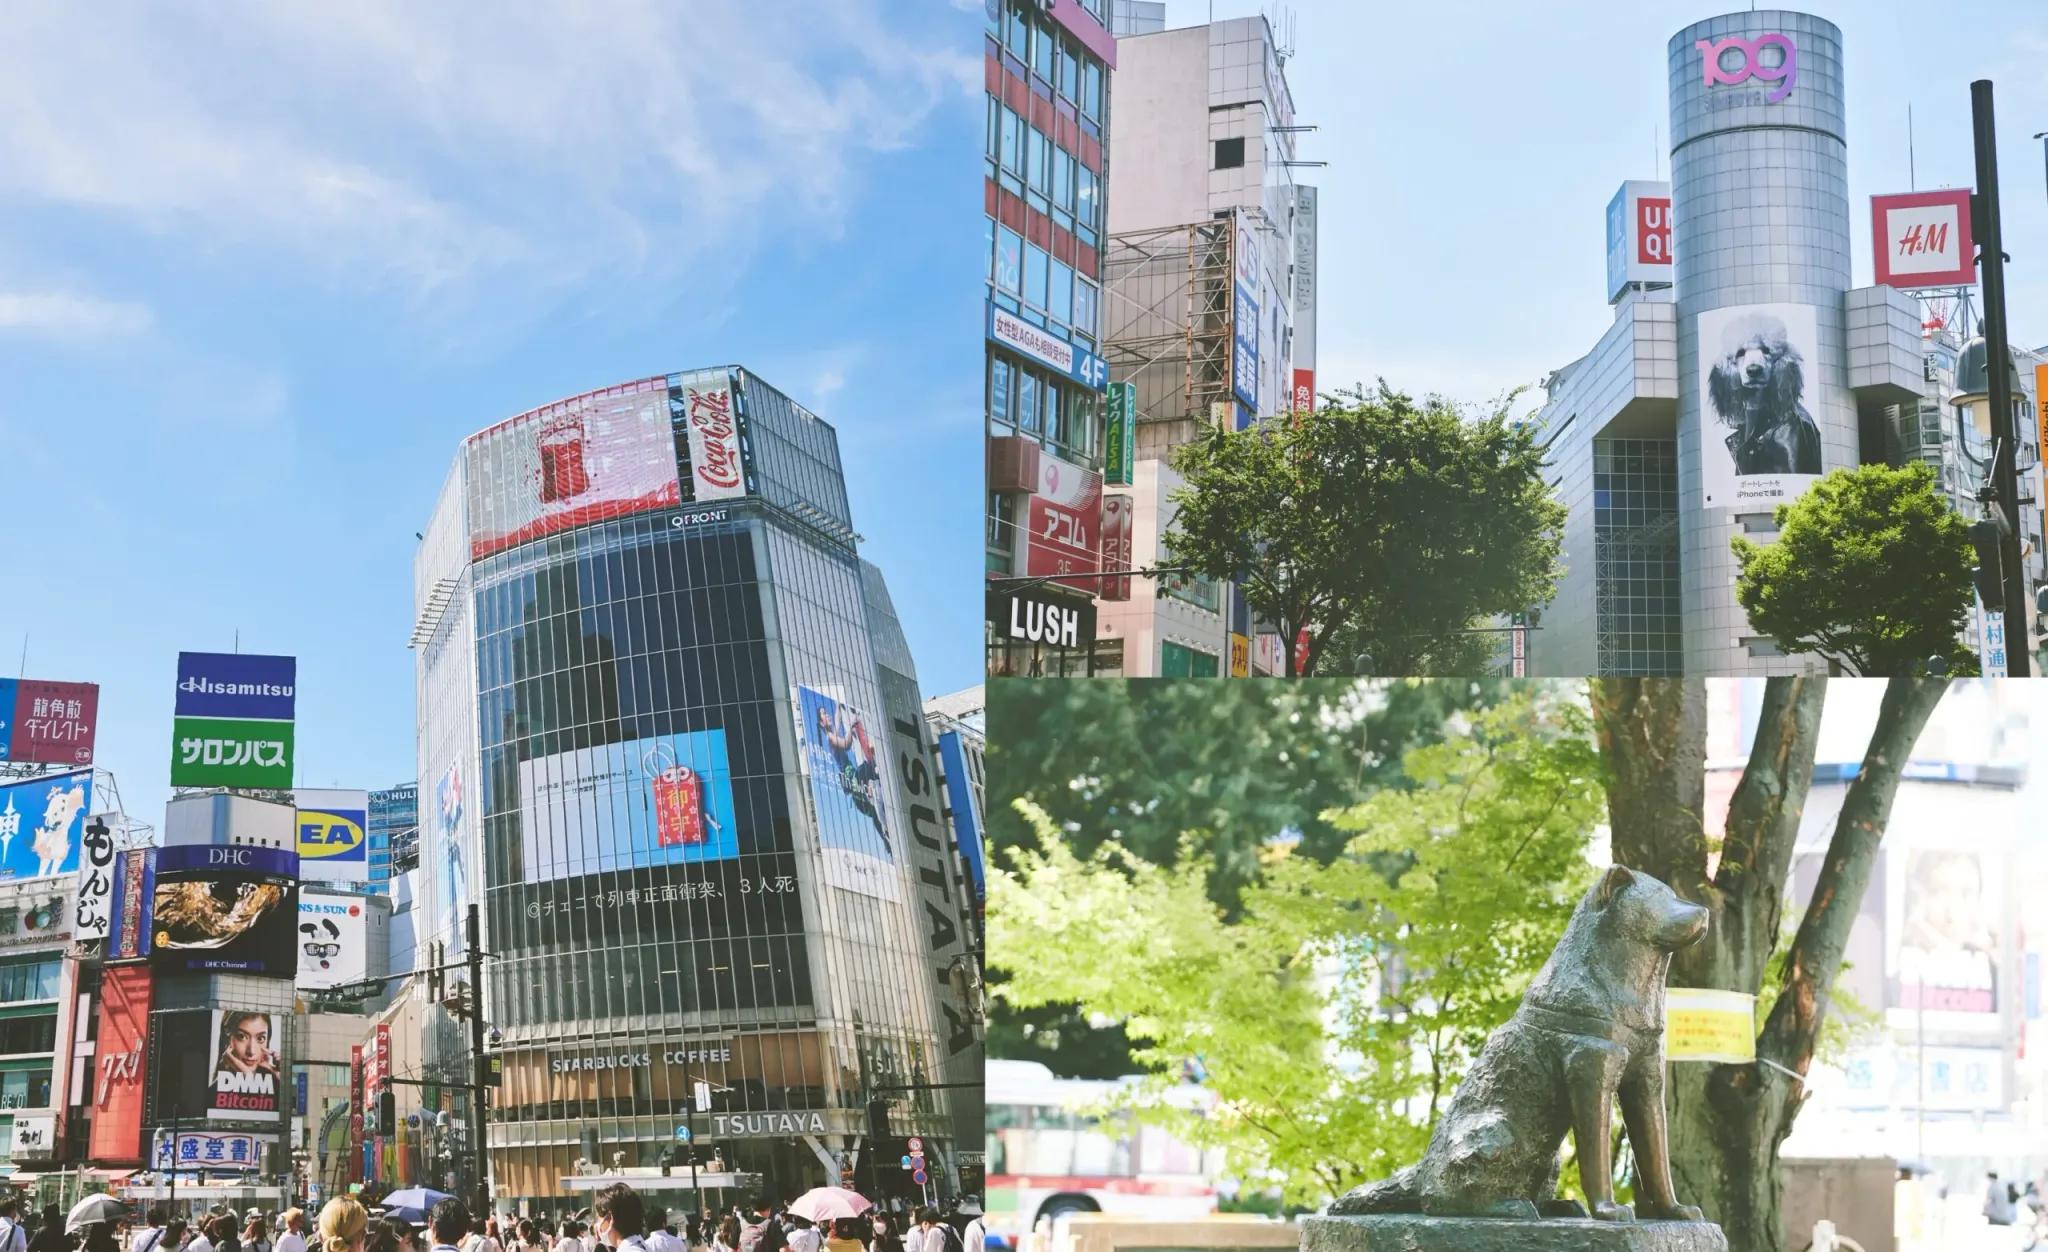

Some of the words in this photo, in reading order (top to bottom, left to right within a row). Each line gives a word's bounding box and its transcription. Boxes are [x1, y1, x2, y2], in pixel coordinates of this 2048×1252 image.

[1695, 33, 1799, 103] 109
[1899, 222, 1948, 256] H&M
[1080, 354, 1105, 387] 4F
[1108, 388, 1122, 423] レイク
[688, 387, 740, 488] Coca-Cola
[1108, 424, 1121, 471] ALSA
[1737, 489, 1784, 498] iPhoneで撮影
[671, 509, 728, 528] QFRONT
[1044, 507, 1087, 549] アコム
[1010, 597, 1078, 648] LUSH
[179, 677, 294, 698] Hisamitsu
[33, 697, 82, 719] 龍角散
[24, 718, 88, 741] ダイレクト
[181, 737, 286, 768] サロンパス
[666, 788, 691, 833] 御守
[301, 823, 354, 845] EA
[209, 848, 252, 866] DHC
[76, 816, 114, 935] もんじゃ
[894, 713, 975, 1056] TSUTAYA
[315, 904, 321, 915] &
[323, 905, 347, 915] SUN
[542, 876, 800, 916] チェコで列車正面衝突、3人死
[204, 960, 220, 969] DHC
[221, 961, 247, 969] Channel
[97, 1037, 144, 1105] クスリ
[377, 1031, 388, 1084] カラオ
[552, 1052, 653, 1073] STARBUCKS
[662, 1048, 731, 1066] COFFEE
[217, 1070, 275, 1095] DMM
[215, 1092, 273, 1110] Bitcoin
[714, 1112, 826, 1136] TSUTAYA
